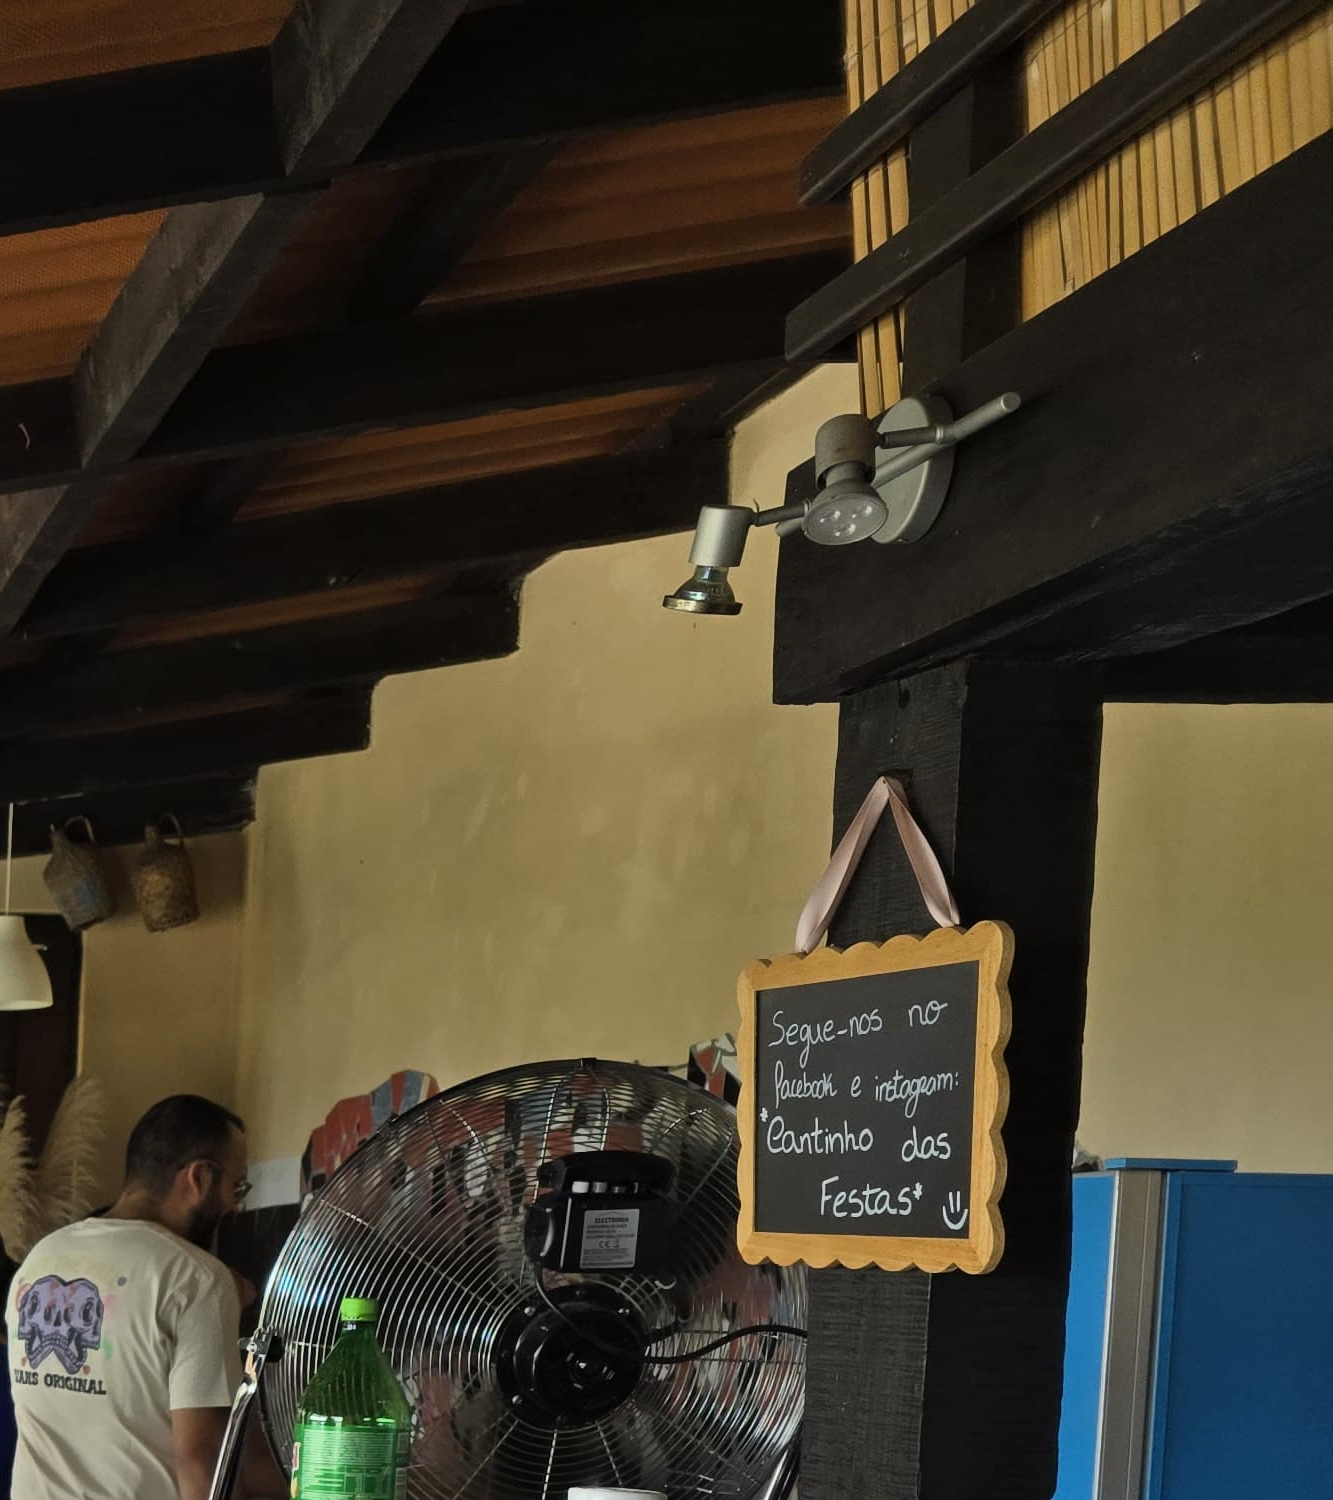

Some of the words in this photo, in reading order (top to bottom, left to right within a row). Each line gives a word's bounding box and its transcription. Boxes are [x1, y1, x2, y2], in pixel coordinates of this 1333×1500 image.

[768, 1008, 882, 1068] Segue-nos
[908, 1000, 948, 1027] no
[851, 1075, 862, 1097] e
[901, 1126, 951, 1162] das
[13, 1369, 38, 1386] VANS
[44, 1373, 107, 1395] ORIGINAL
